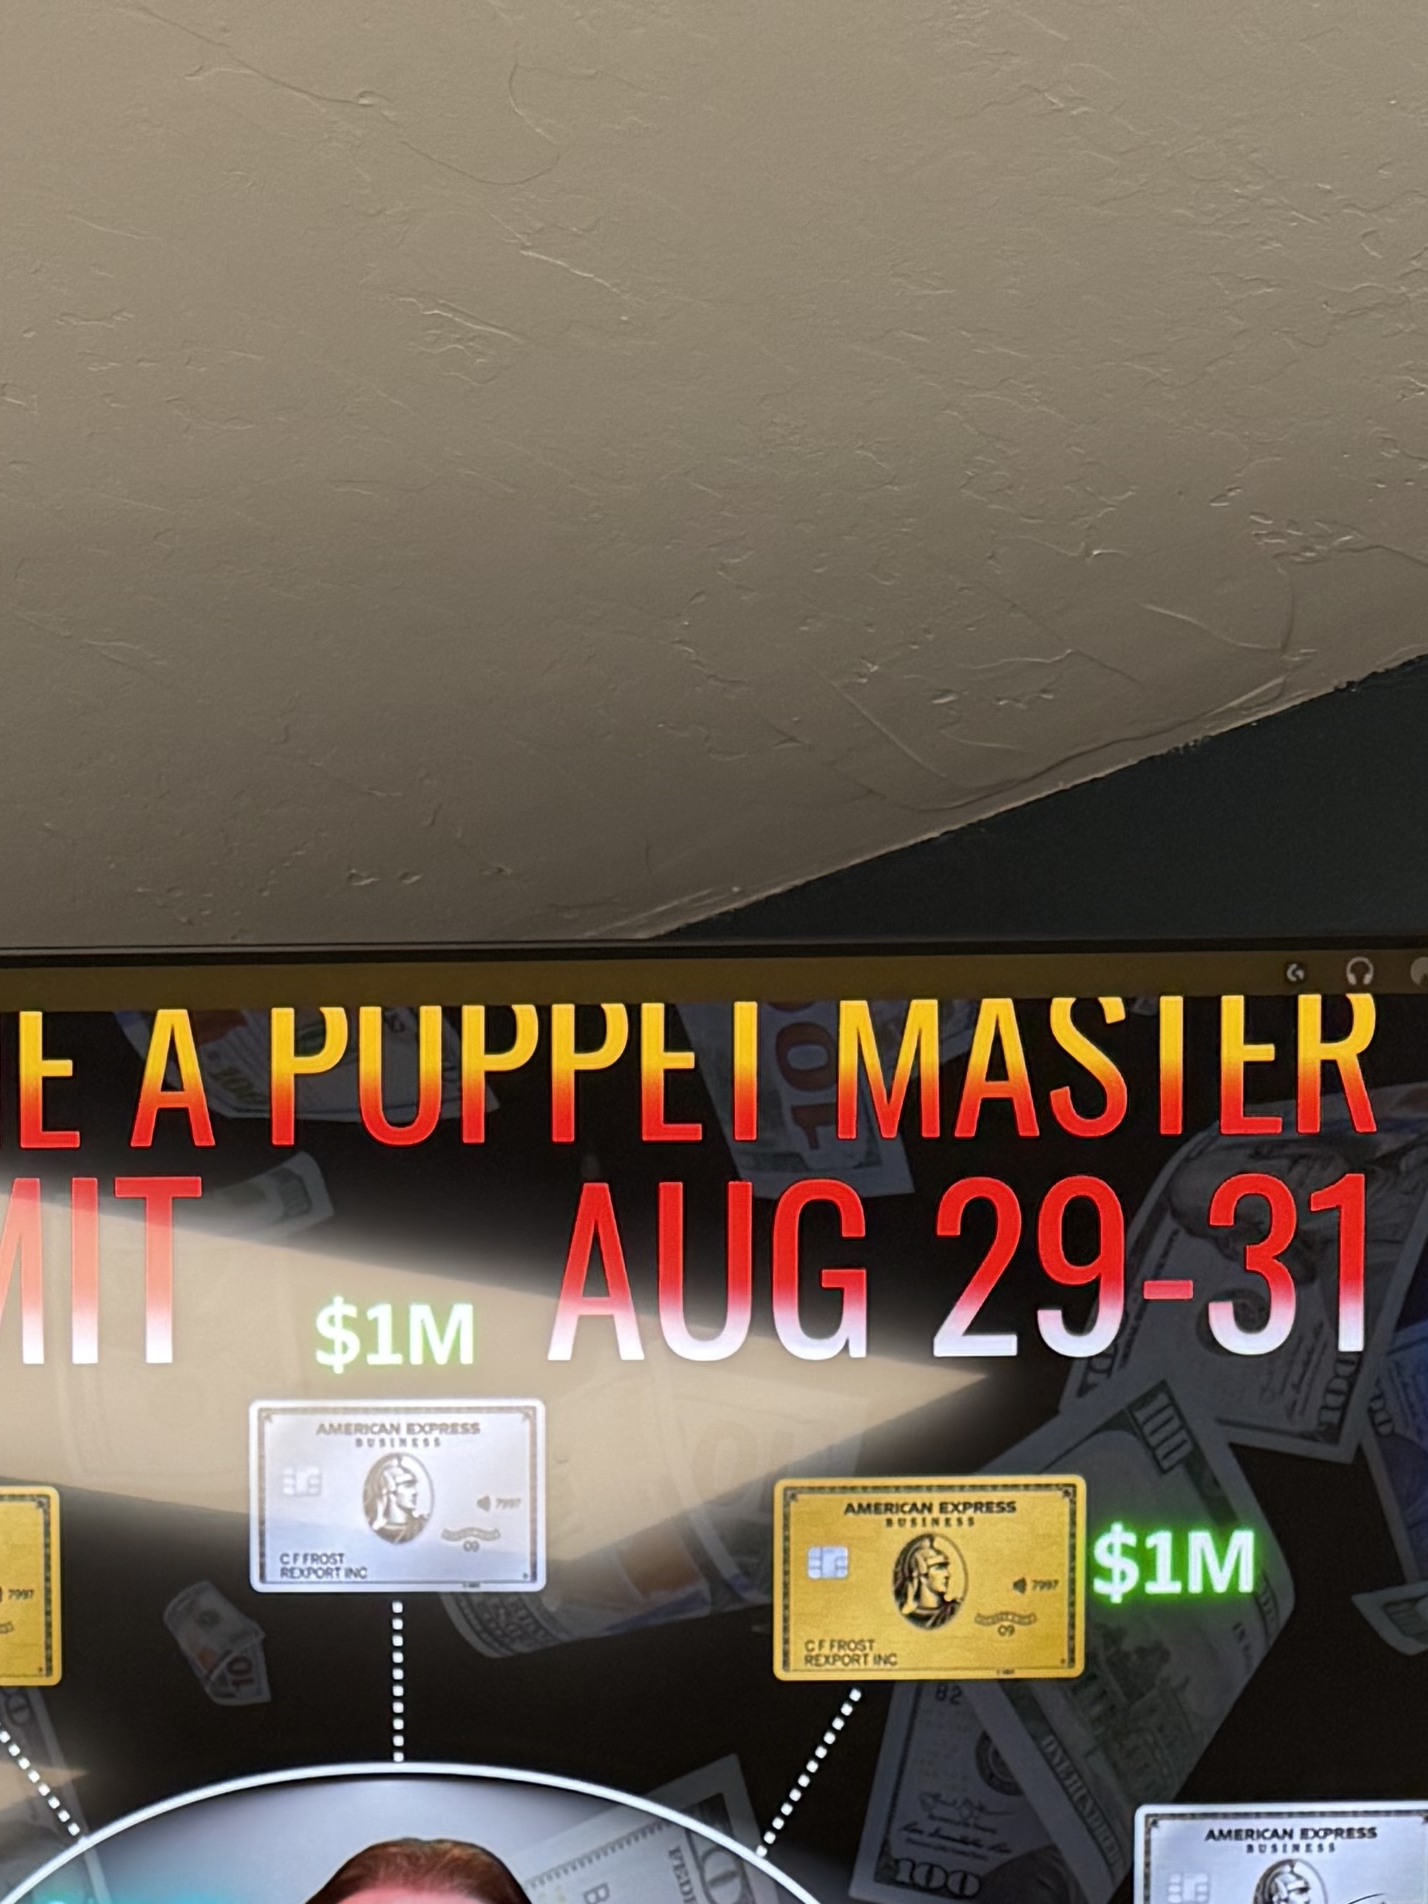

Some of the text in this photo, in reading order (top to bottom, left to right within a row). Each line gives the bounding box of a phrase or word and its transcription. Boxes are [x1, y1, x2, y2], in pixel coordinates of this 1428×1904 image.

[130, 1008, 215, 1148] A
[547, 1177, 869, 1363] AUG
[933, 1173, 1366, 1358] 29-31
[315, 1295, 475, 1374] $1M
[316, 1422, 481, 1436] AMERICAN EXPRESS
[355, 1437, 442, 1448] BUSINESS
[843, 1500, 1017, 1516] AMERICAN EXPRESS
[885, 1516, 975, 1528] BUSINESS
[280, 1552, 344, 1565] C F FROST
[1092, 1522, 1256, 1604] $1M
[280, 1566, 367, 1580] REXPORT INC
[805, 1638, 875, 1652] C F FROST
[804, 1653, 898, 1667] REXPORT INC
[1204, 1826, 1378, 1842] AMERICAN EXPRESS
[1246, 1842, 1336, 1854] BUSINESS
